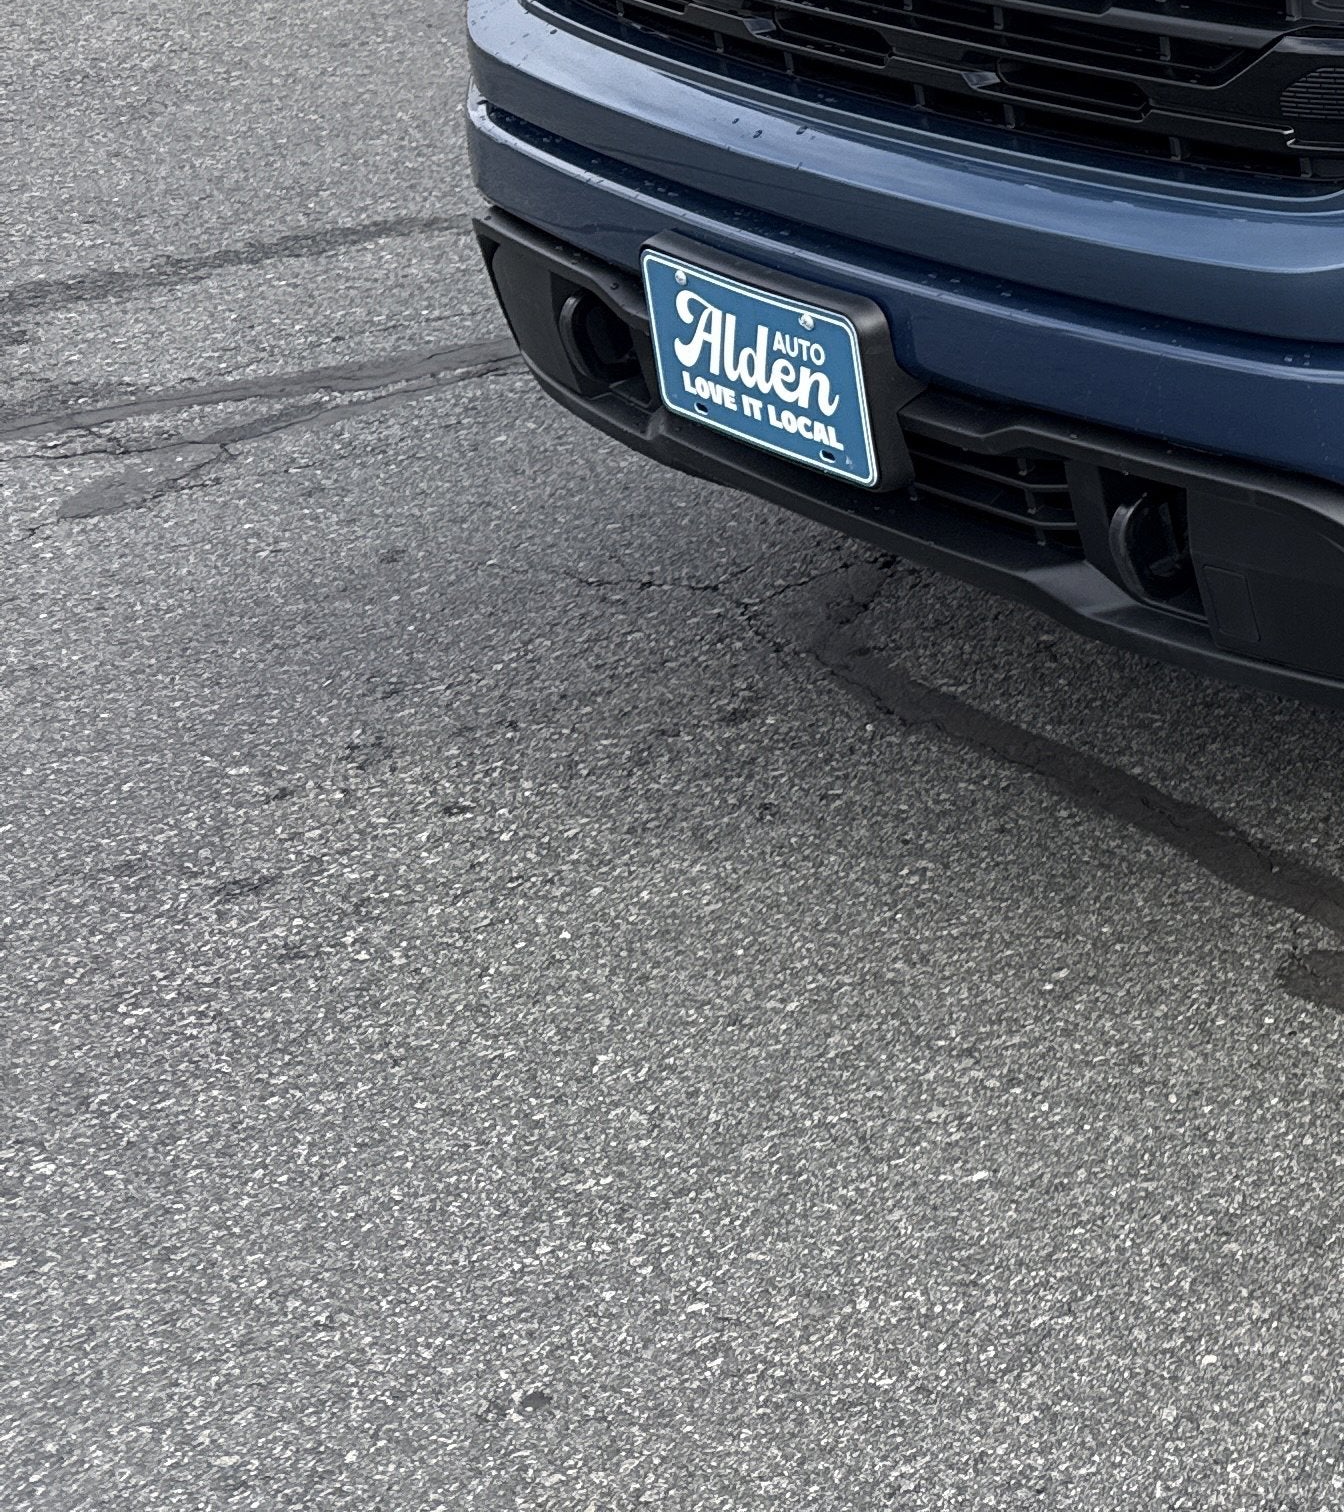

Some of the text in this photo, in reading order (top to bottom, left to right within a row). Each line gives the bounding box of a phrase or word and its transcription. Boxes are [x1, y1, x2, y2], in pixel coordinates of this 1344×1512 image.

[674, 289, 840, 416] Alden
[773, 331, 826, 366] AUTO
[682, 371, 845, 451] LOVE IT LOCAL
